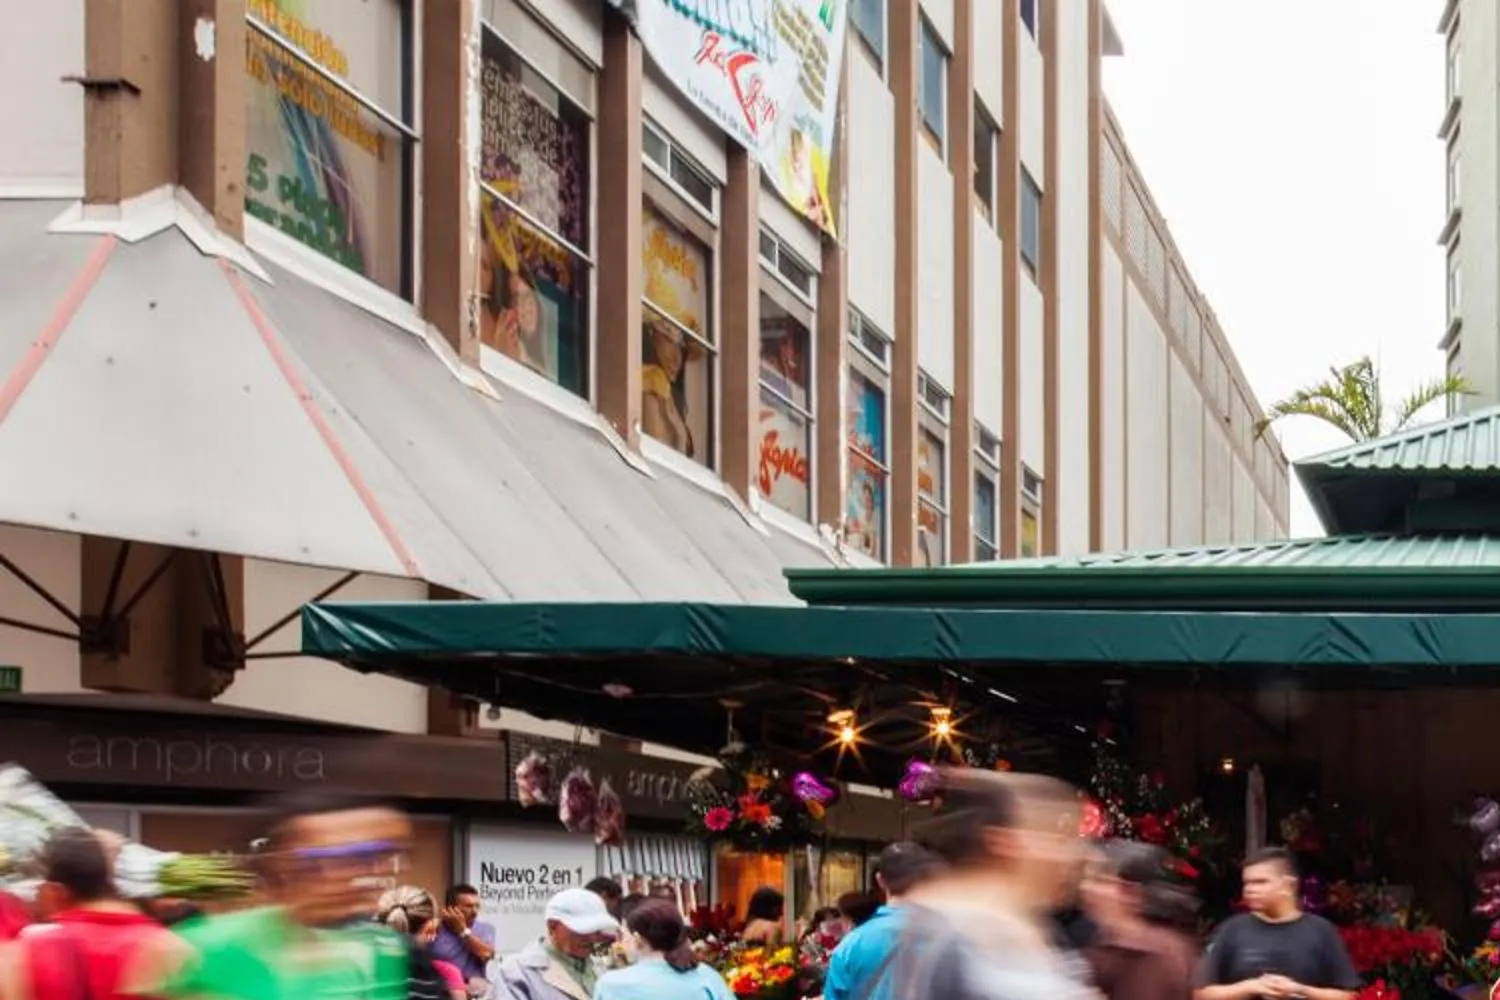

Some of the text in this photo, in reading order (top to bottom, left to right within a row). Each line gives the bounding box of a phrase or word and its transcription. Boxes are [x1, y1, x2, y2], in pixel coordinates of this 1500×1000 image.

[66, 732, 326, 782] amphora
[481, 861, 583, 887] Nuevo 2 en 1
[480, 882, 525, 903] Beyond
